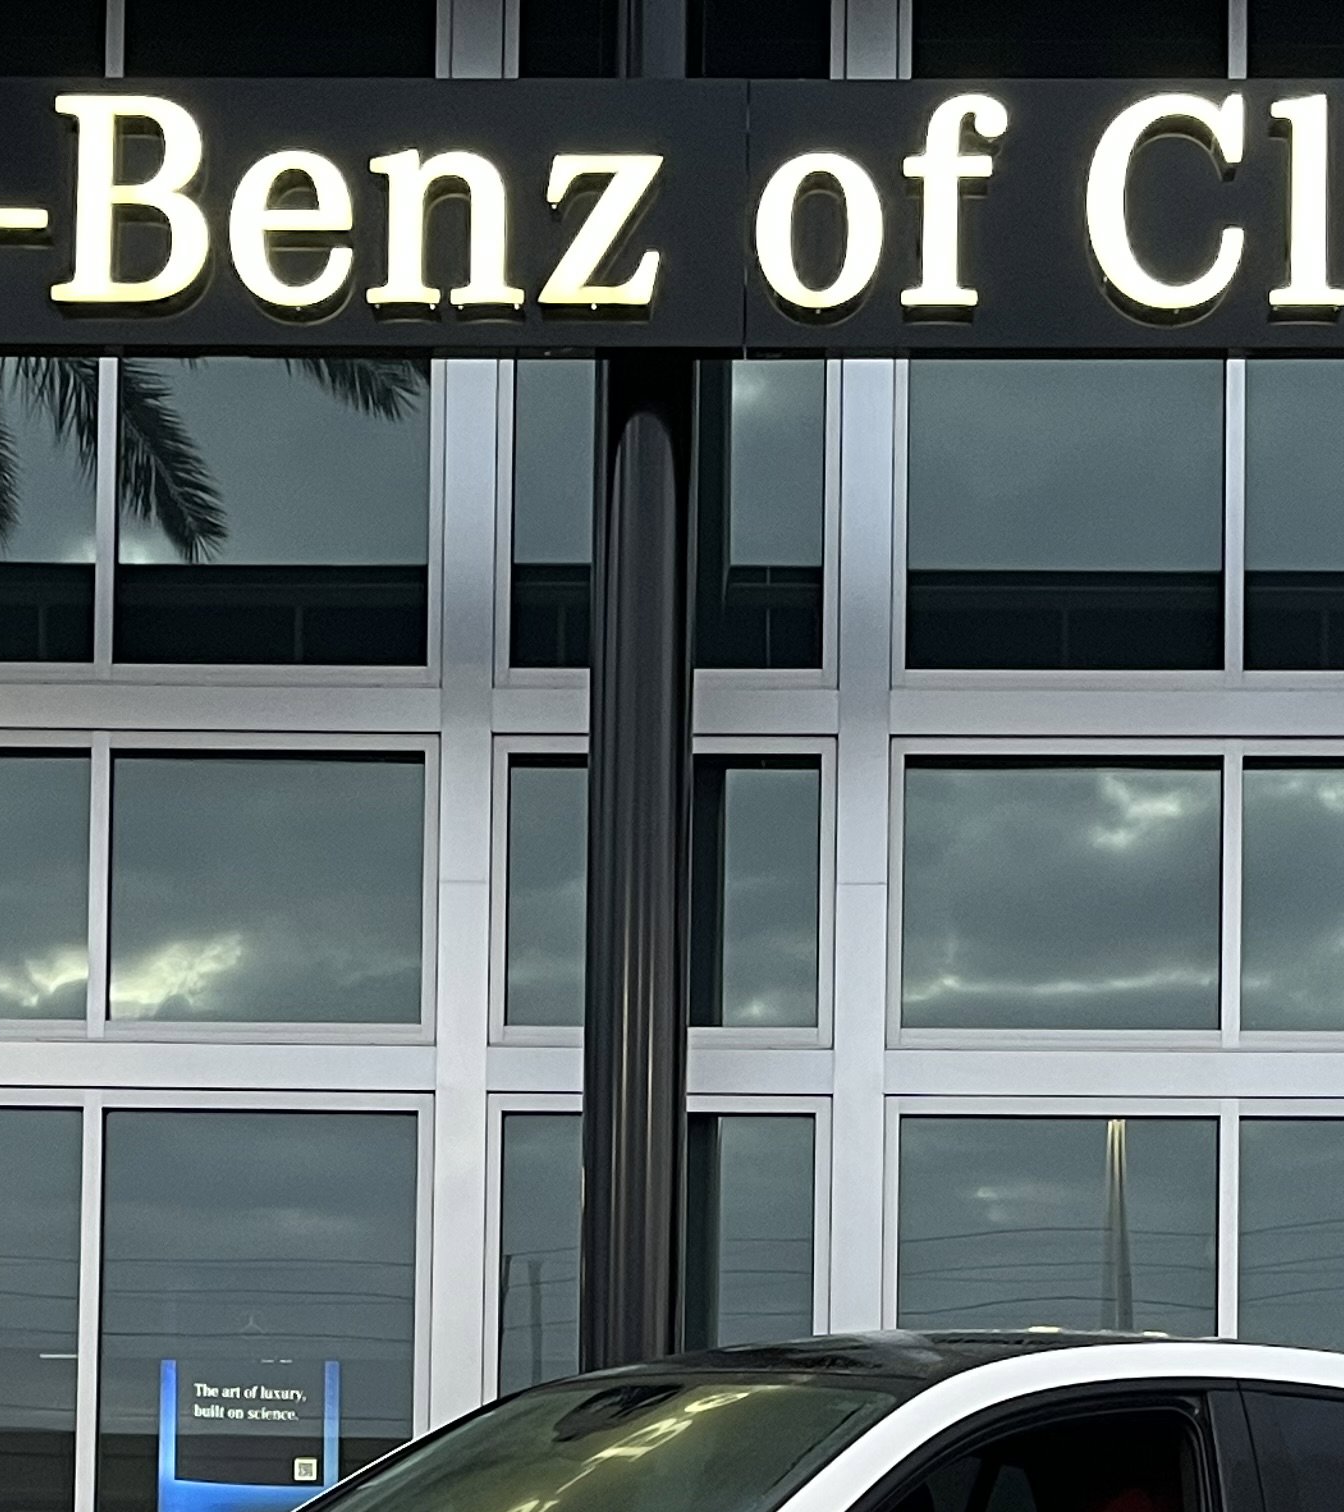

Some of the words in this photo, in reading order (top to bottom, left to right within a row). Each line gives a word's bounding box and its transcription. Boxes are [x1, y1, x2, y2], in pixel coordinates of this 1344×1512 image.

[754, 92, 1010, 310] of
[194, 1382, 219, 1398] The
[221, 1386, 240, 1399] art
[244, 1385, 258, 1399] of
[260, 1385, 307, 1403] luxury,
[194, 1403, 225, 1419] built
[227, 1408, 244, 1420] on
[247, 1406, 299, 1421] science.
